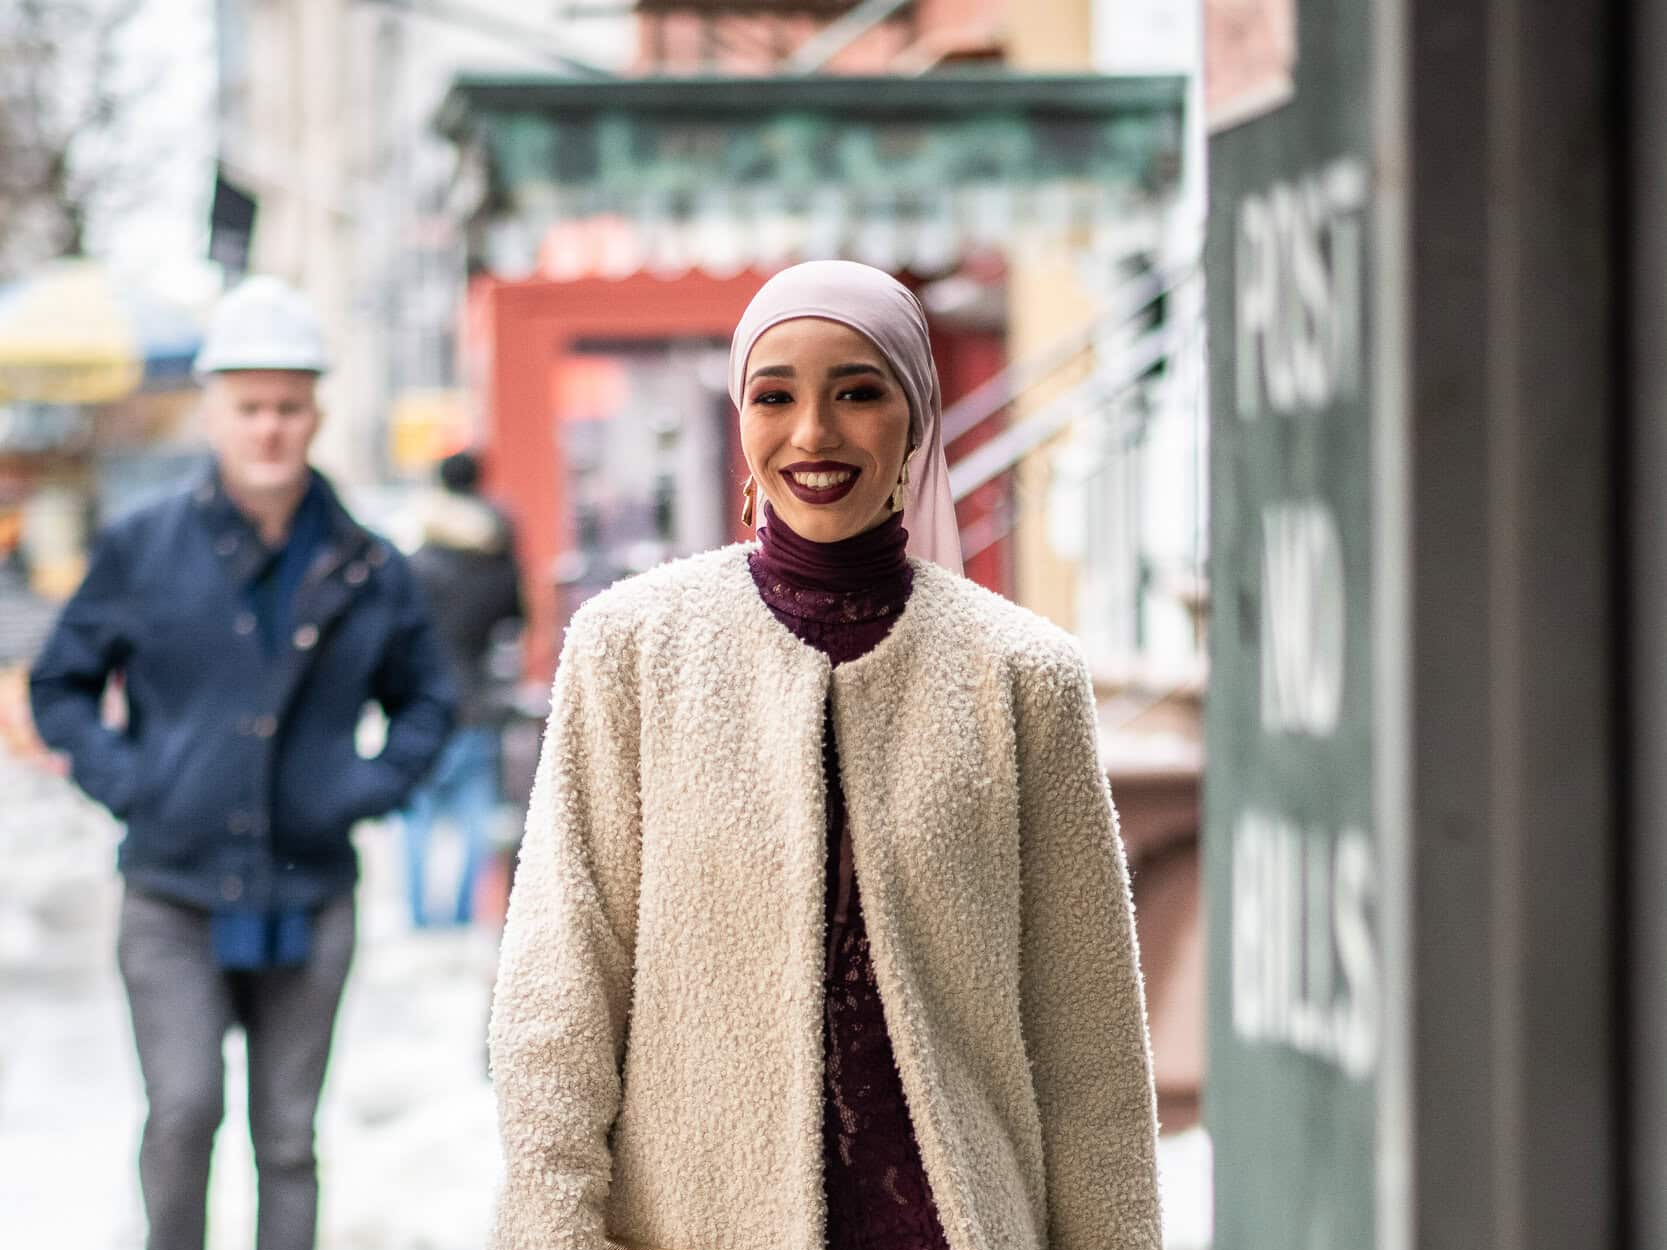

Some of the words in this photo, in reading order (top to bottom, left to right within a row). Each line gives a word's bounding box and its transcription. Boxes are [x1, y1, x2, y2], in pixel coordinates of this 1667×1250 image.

[1234, 158, 1367, 420] POST
[1259, 501, 1346, 737] NO
[1231, 810, 1377, 1078] BILLS
